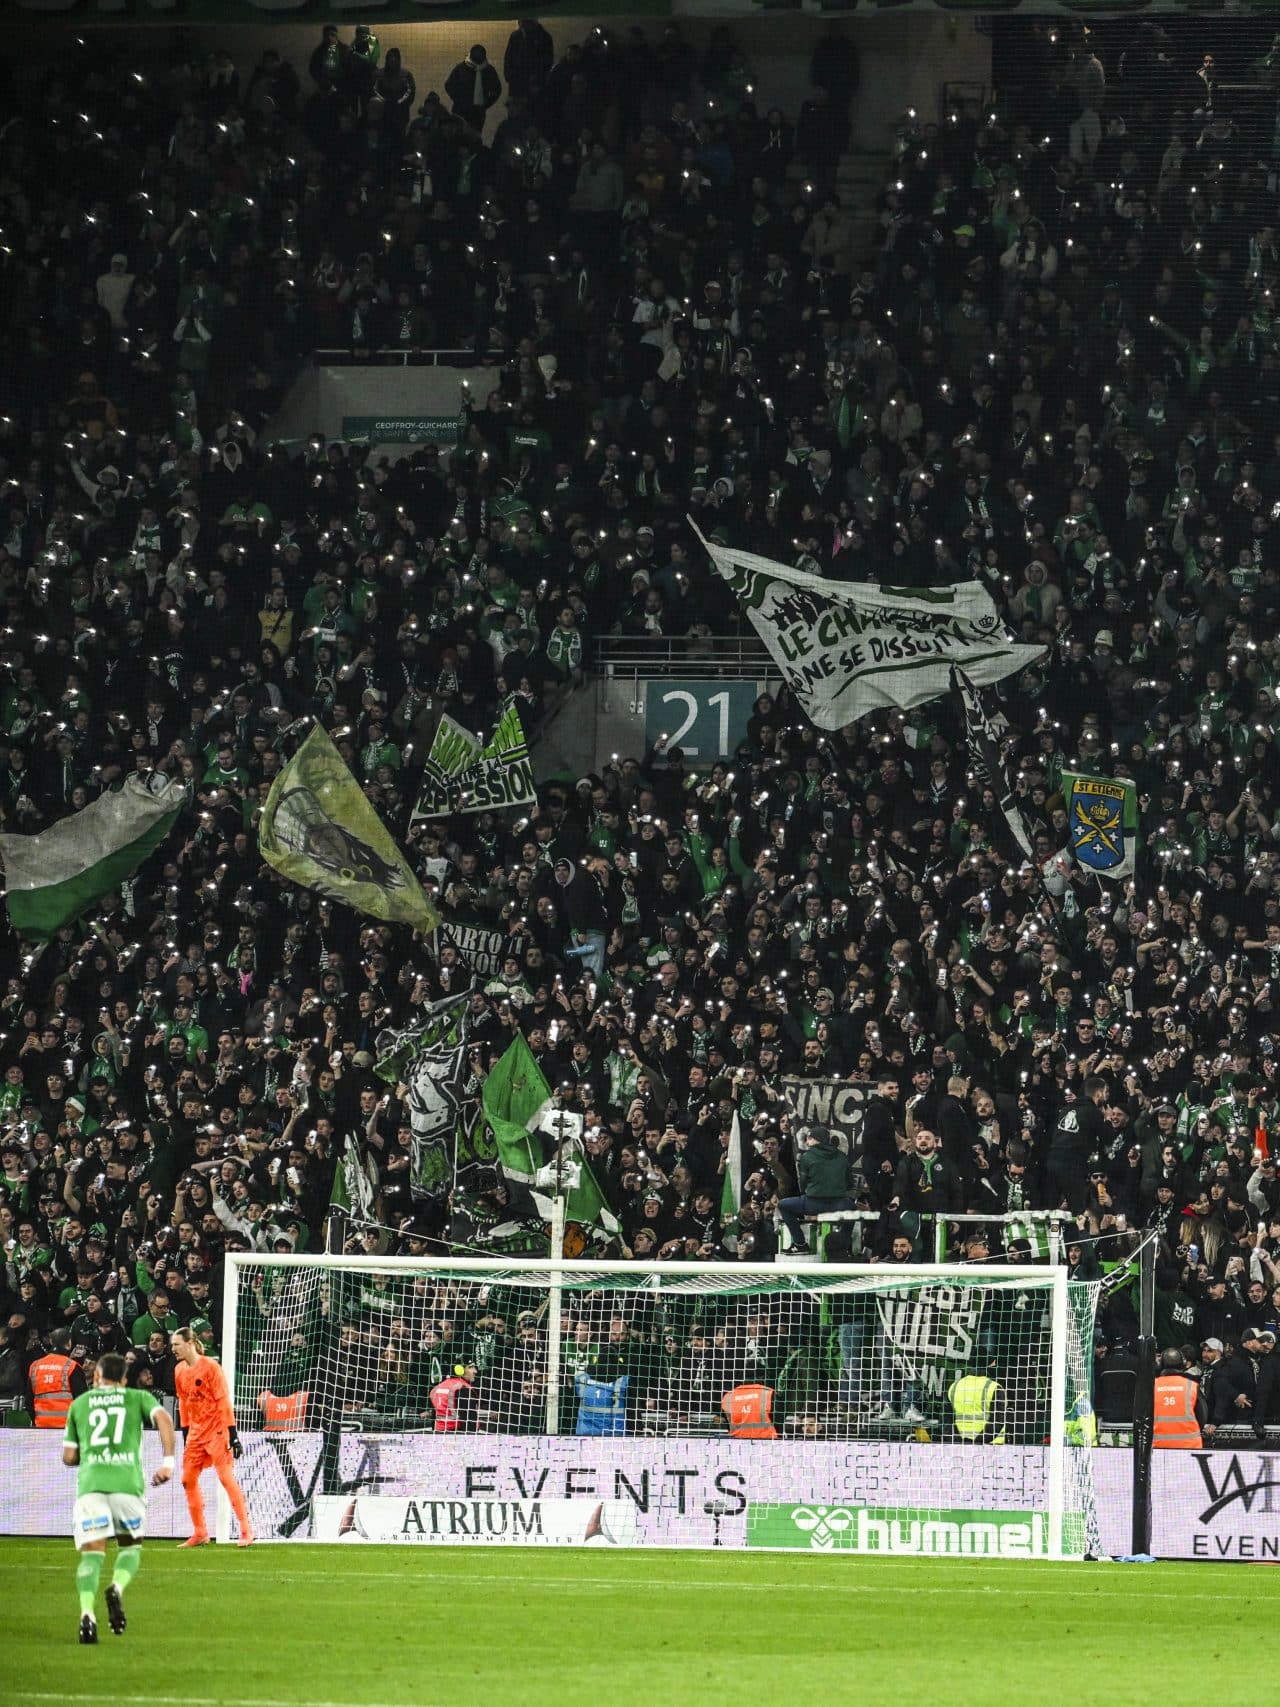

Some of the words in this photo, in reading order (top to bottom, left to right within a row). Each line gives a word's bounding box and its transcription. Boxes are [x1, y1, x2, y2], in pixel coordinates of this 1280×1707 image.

[777, 625, 814, 662] LE
[839, 644, 866, 674] SE
[661, 691, 731, 756] 21
[1078, 783, 1089, 792] ST
[1163, 1396, 1176, 1406] 36
[88, 1407, 126, 1446] 27
[402, 1501, 545, 1536] ATRIUM
[858, 1509, 1044, 1554] hummel
